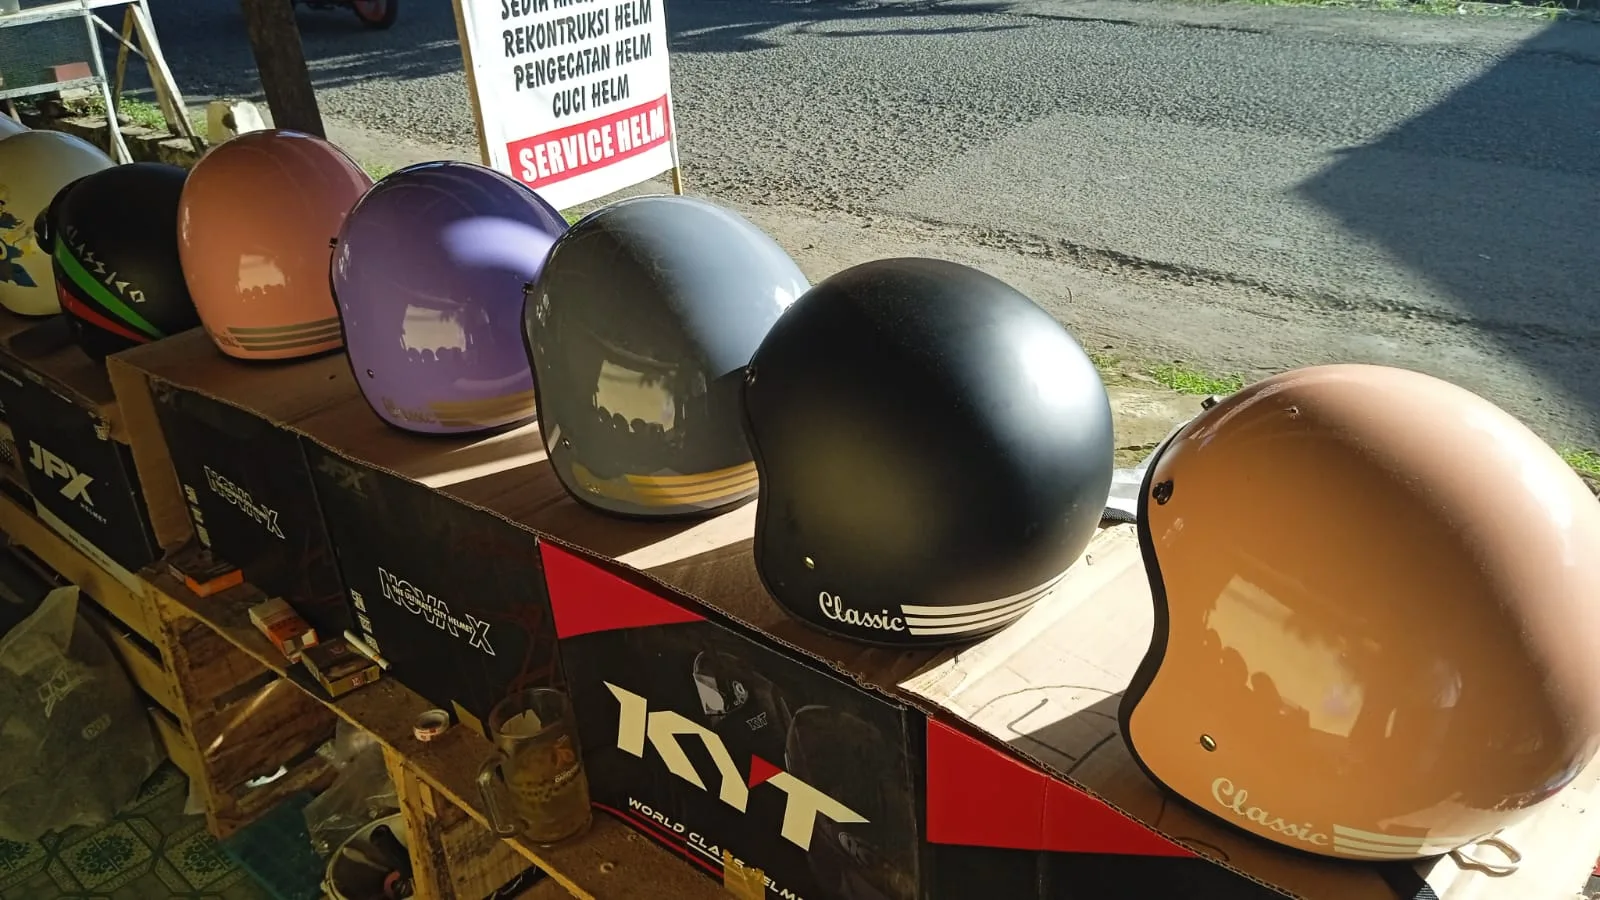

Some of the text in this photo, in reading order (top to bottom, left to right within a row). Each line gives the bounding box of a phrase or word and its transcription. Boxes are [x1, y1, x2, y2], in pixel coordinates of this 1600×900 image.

[503, 0, 652, 58] REKONTRUKSI HELM
[514, 33, 652, 92] PENGECATAN HELM
[553, 74, 630, 118] CUCI HELM
[519, 105, 665, 182] SERVICE HELM
[29, 440, 95, 506] JPX
[391, 584, 473, 635] THE ULTIMATE CITY HELMET
[818, 591, 905, 632] Classic
[603, 680, 871, 852] KYT
[628, 796, 685, 835] WORLD
[688, 831, 746, 869] CLAS
[1211, 777, 1329, 846] Classic
